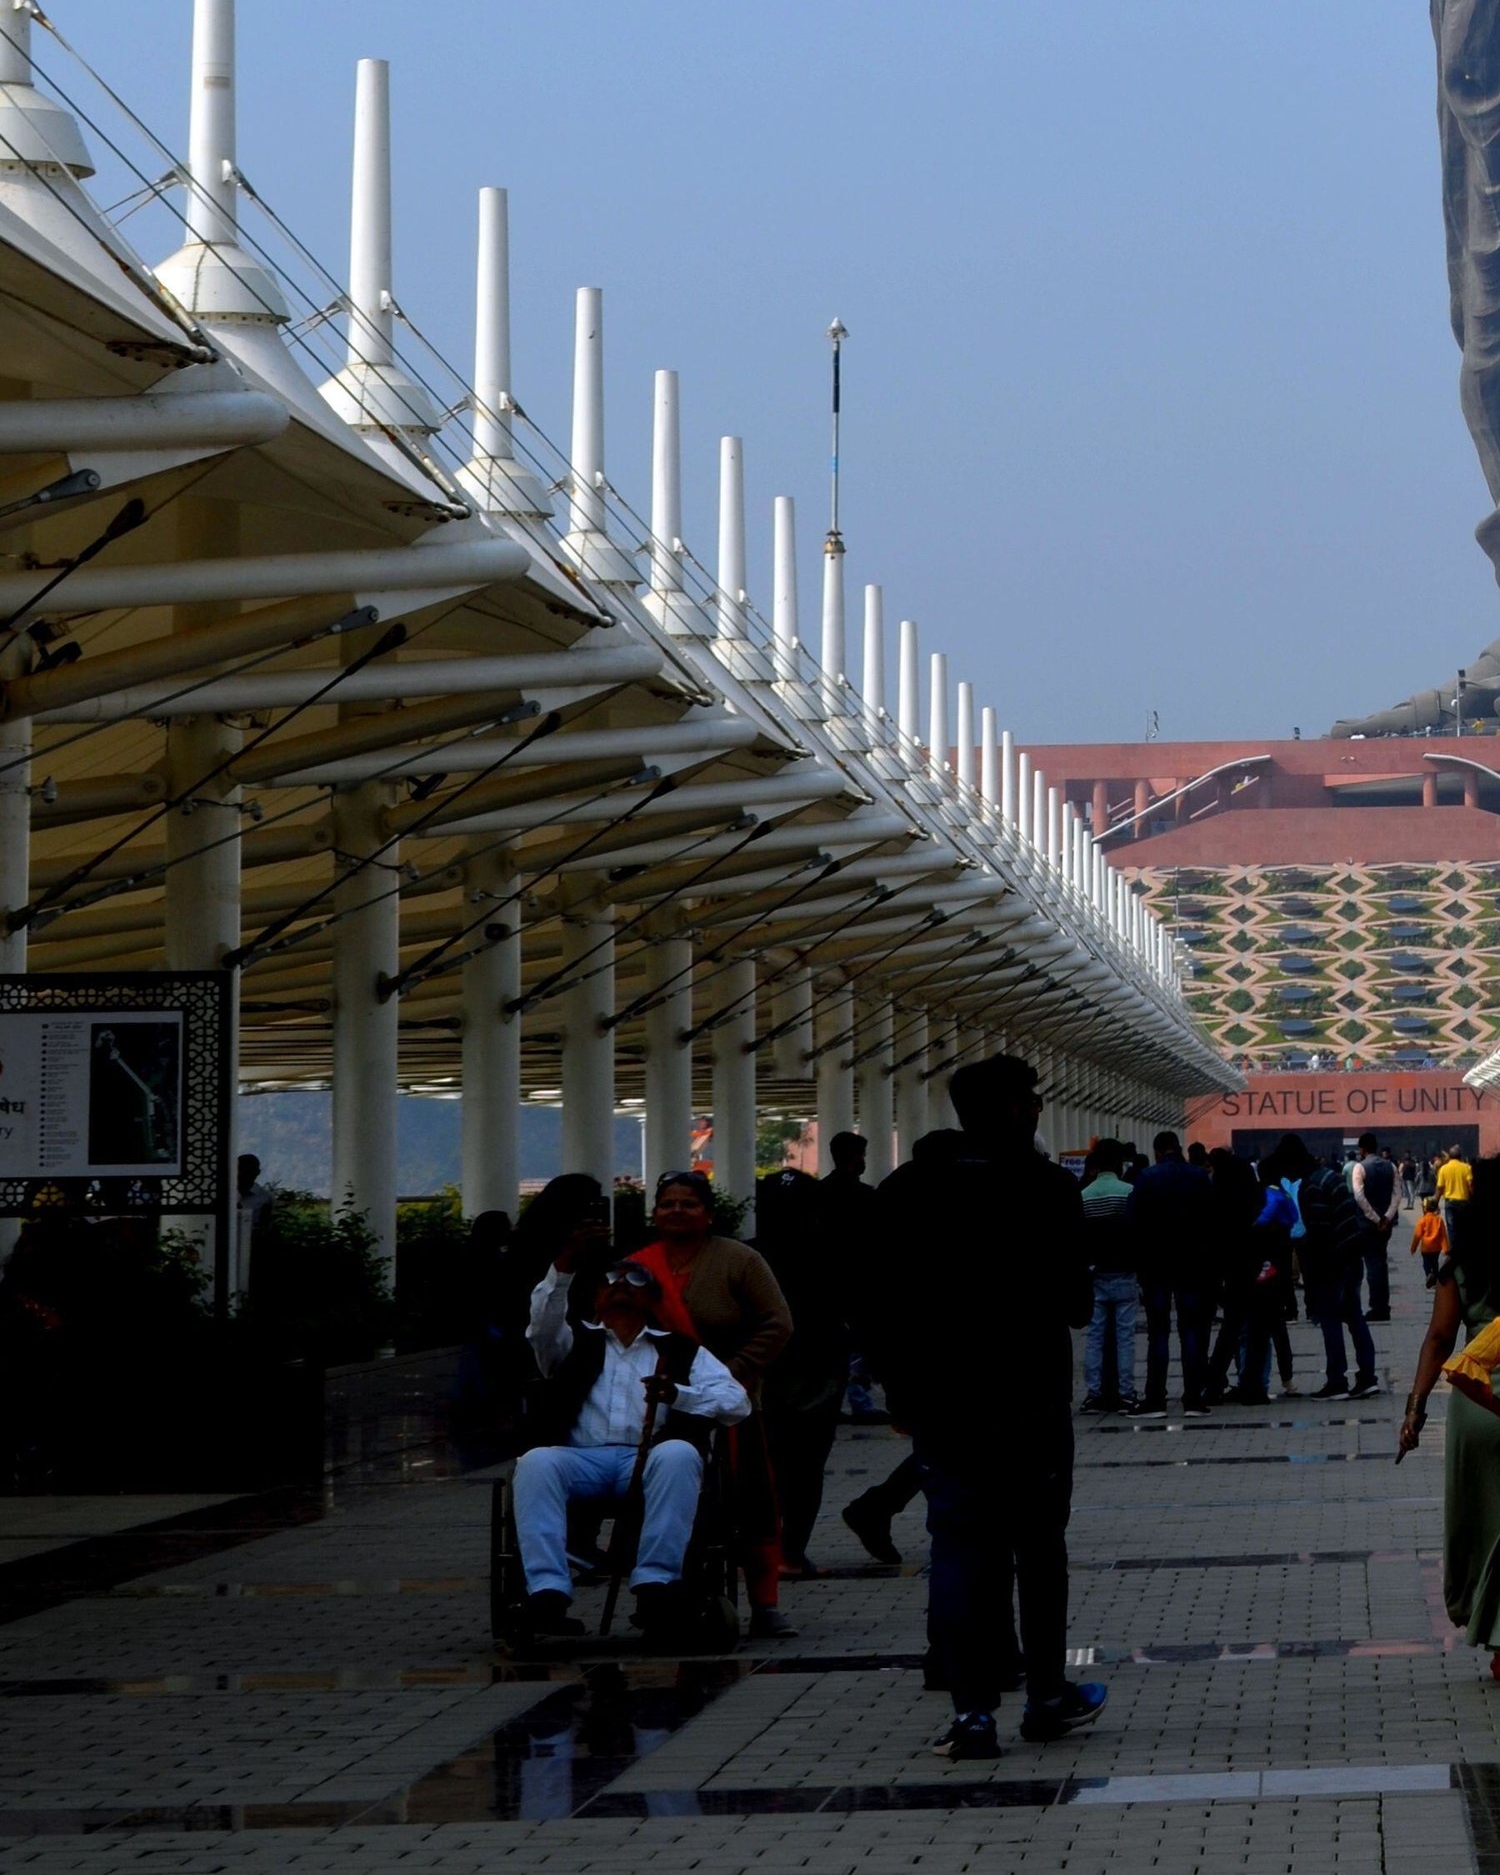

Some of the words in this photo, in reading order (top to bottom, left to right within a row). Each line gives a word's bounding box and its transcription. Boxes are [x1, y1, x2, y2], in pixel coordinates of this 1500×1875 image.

[1222, 1090, 1336, 1116] STATUE
[1346, 1088, 1387, 1114] OF
[1398, 1087, 1485, 1112] UNITY
